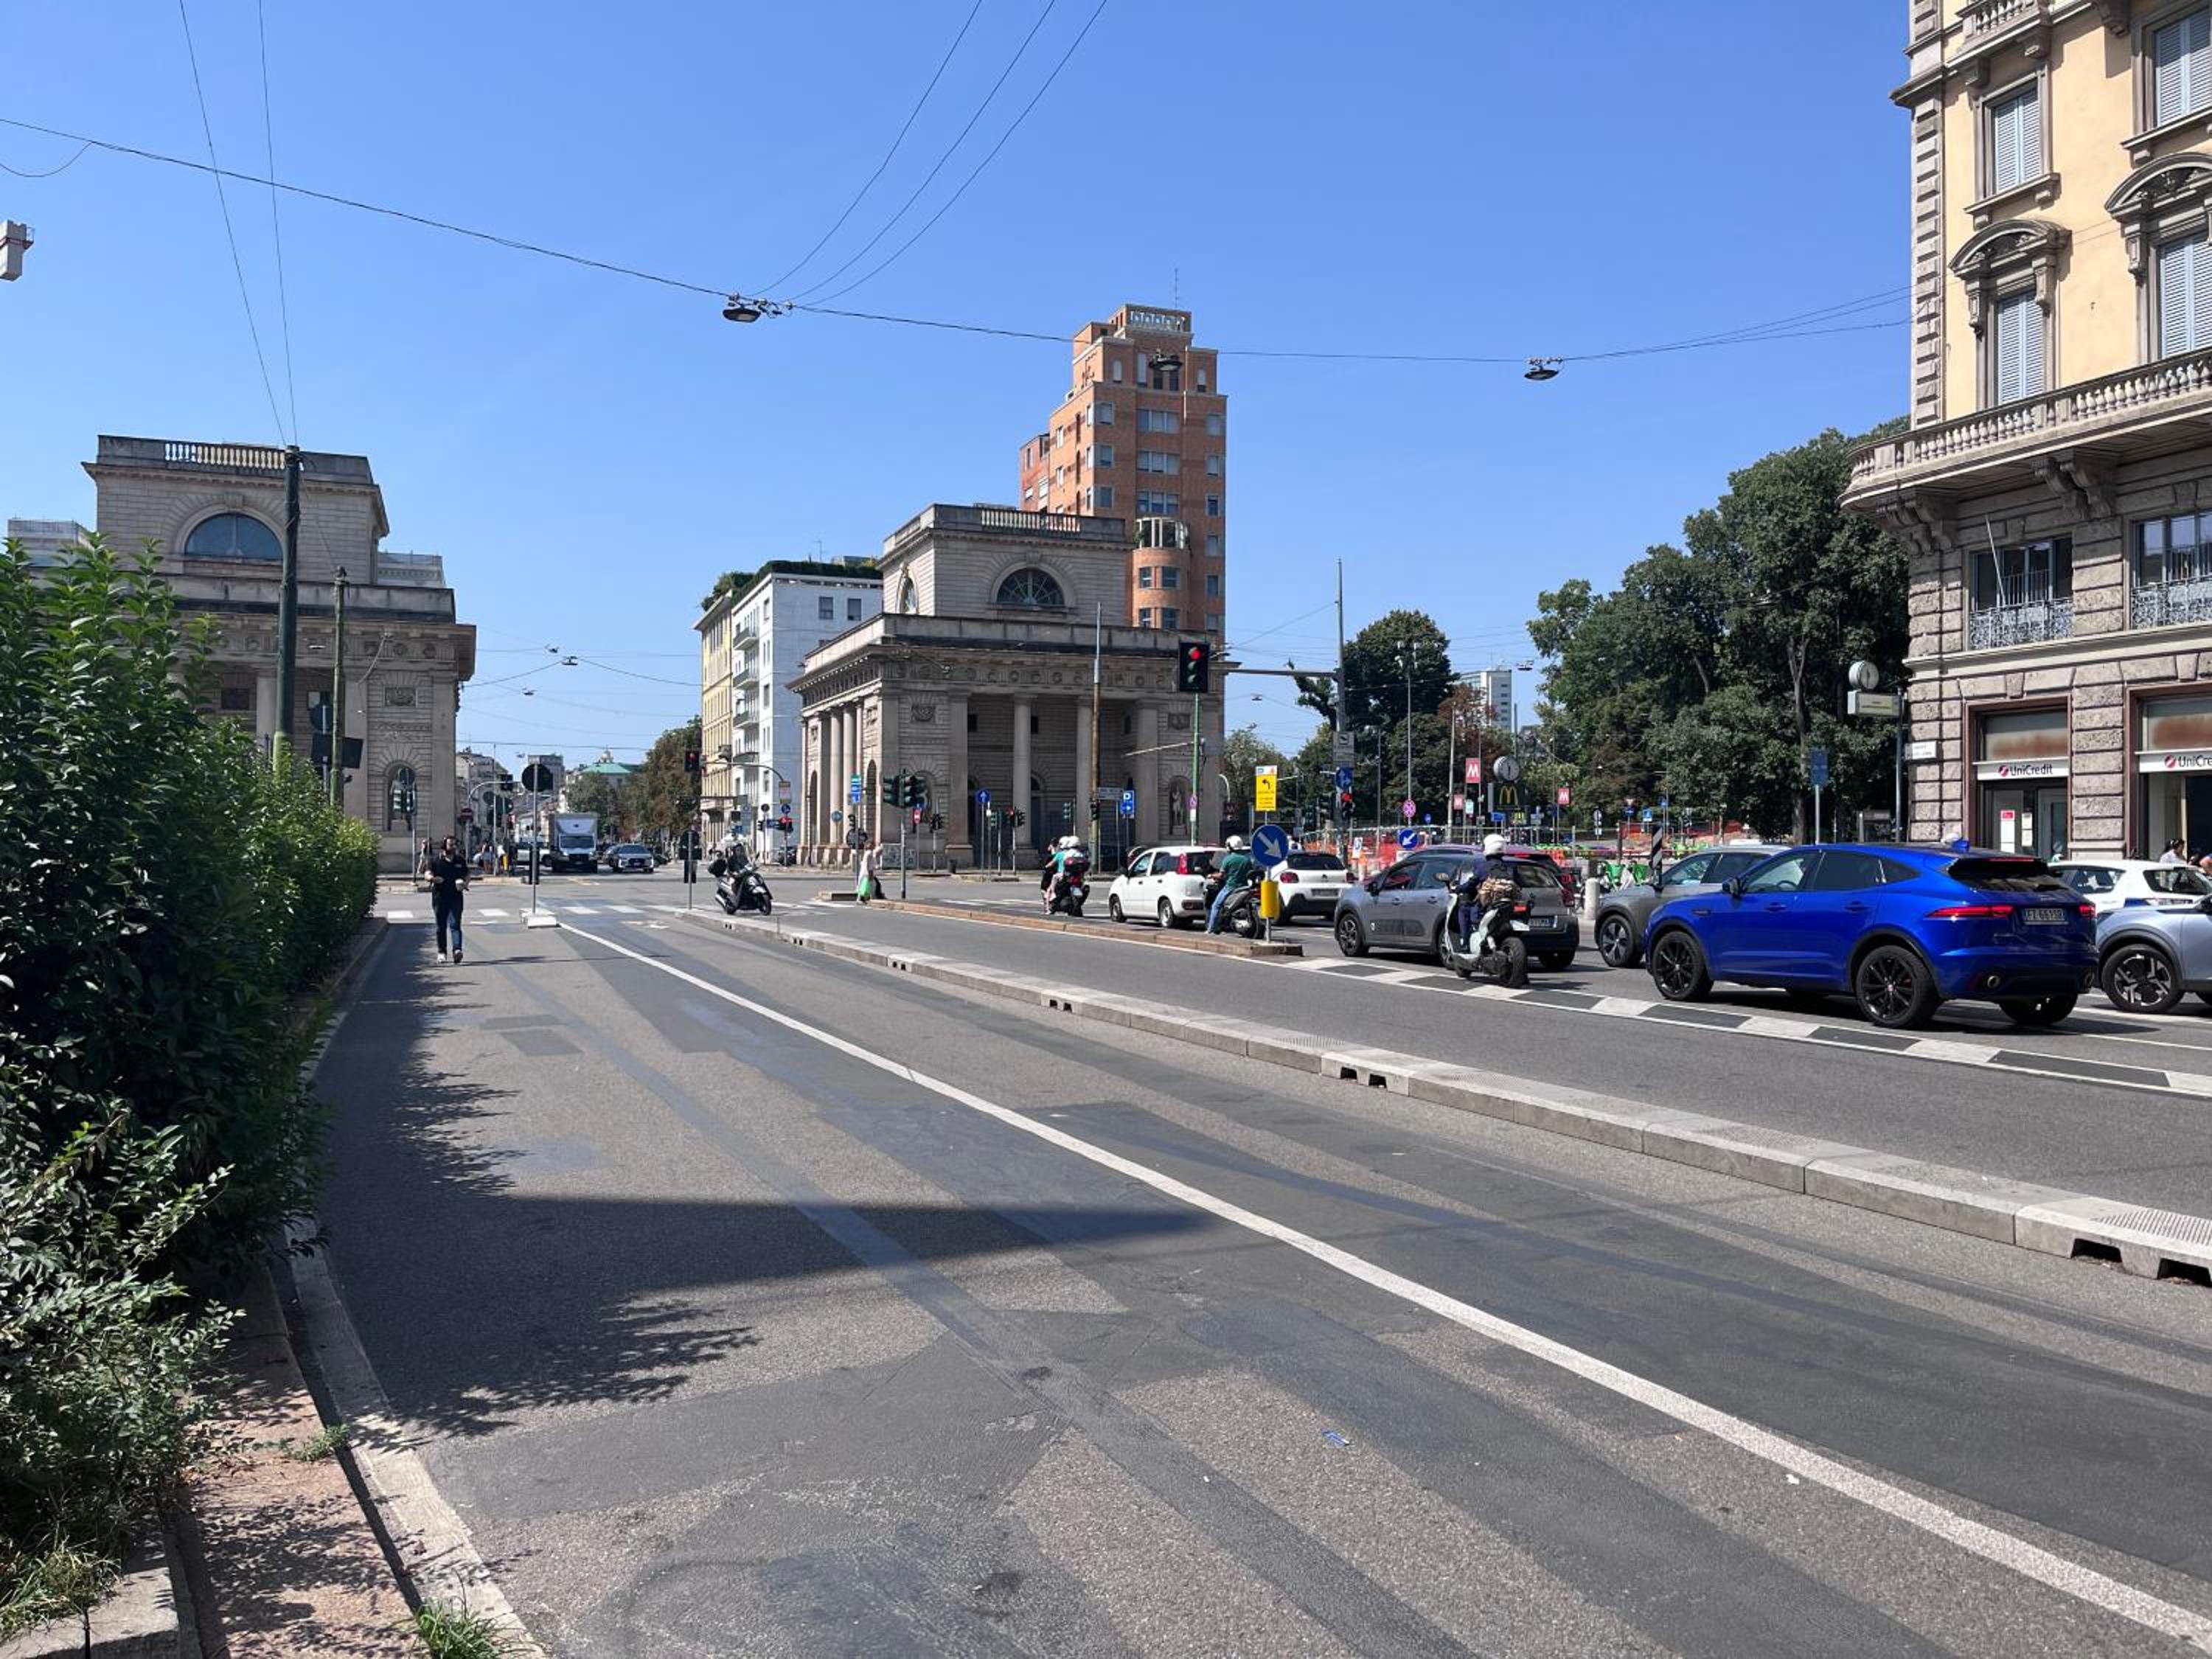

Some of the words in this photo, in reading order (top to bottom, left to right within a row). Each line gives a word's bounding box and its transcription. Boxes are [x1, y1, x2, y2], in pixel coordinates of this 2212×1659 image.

[1467, 764, 1479, 777] M
[2010, 763, 2053, 776] UniCredit
[1123, 793, 1132, 803] P
[1559, 791, 1568, 801] M
